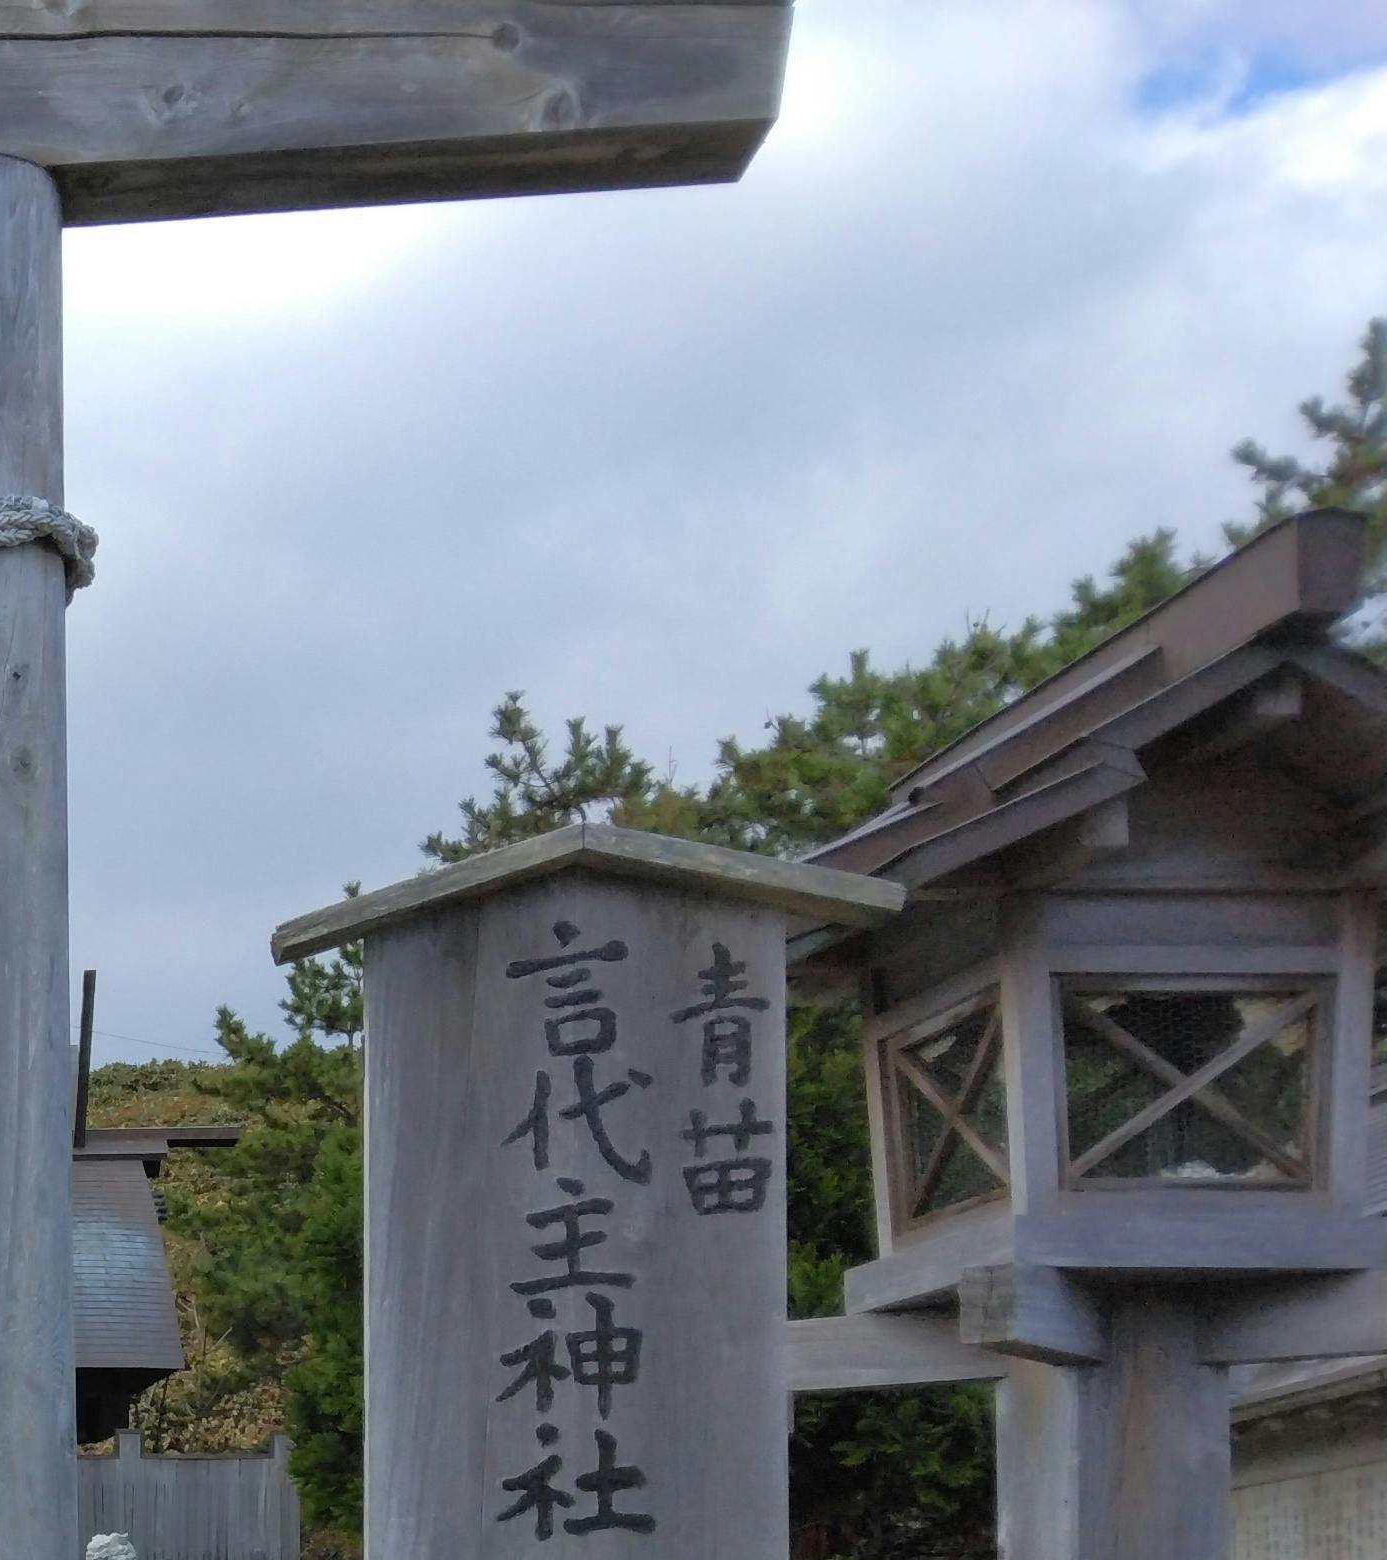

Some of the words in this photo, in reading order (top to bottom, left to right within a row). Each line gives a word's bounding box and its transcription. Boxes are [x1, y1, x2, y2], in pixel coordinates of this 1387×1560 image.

[496, 920, 657, 1541] 言代主神社
[672, 942, 773, 1216] 青苗
